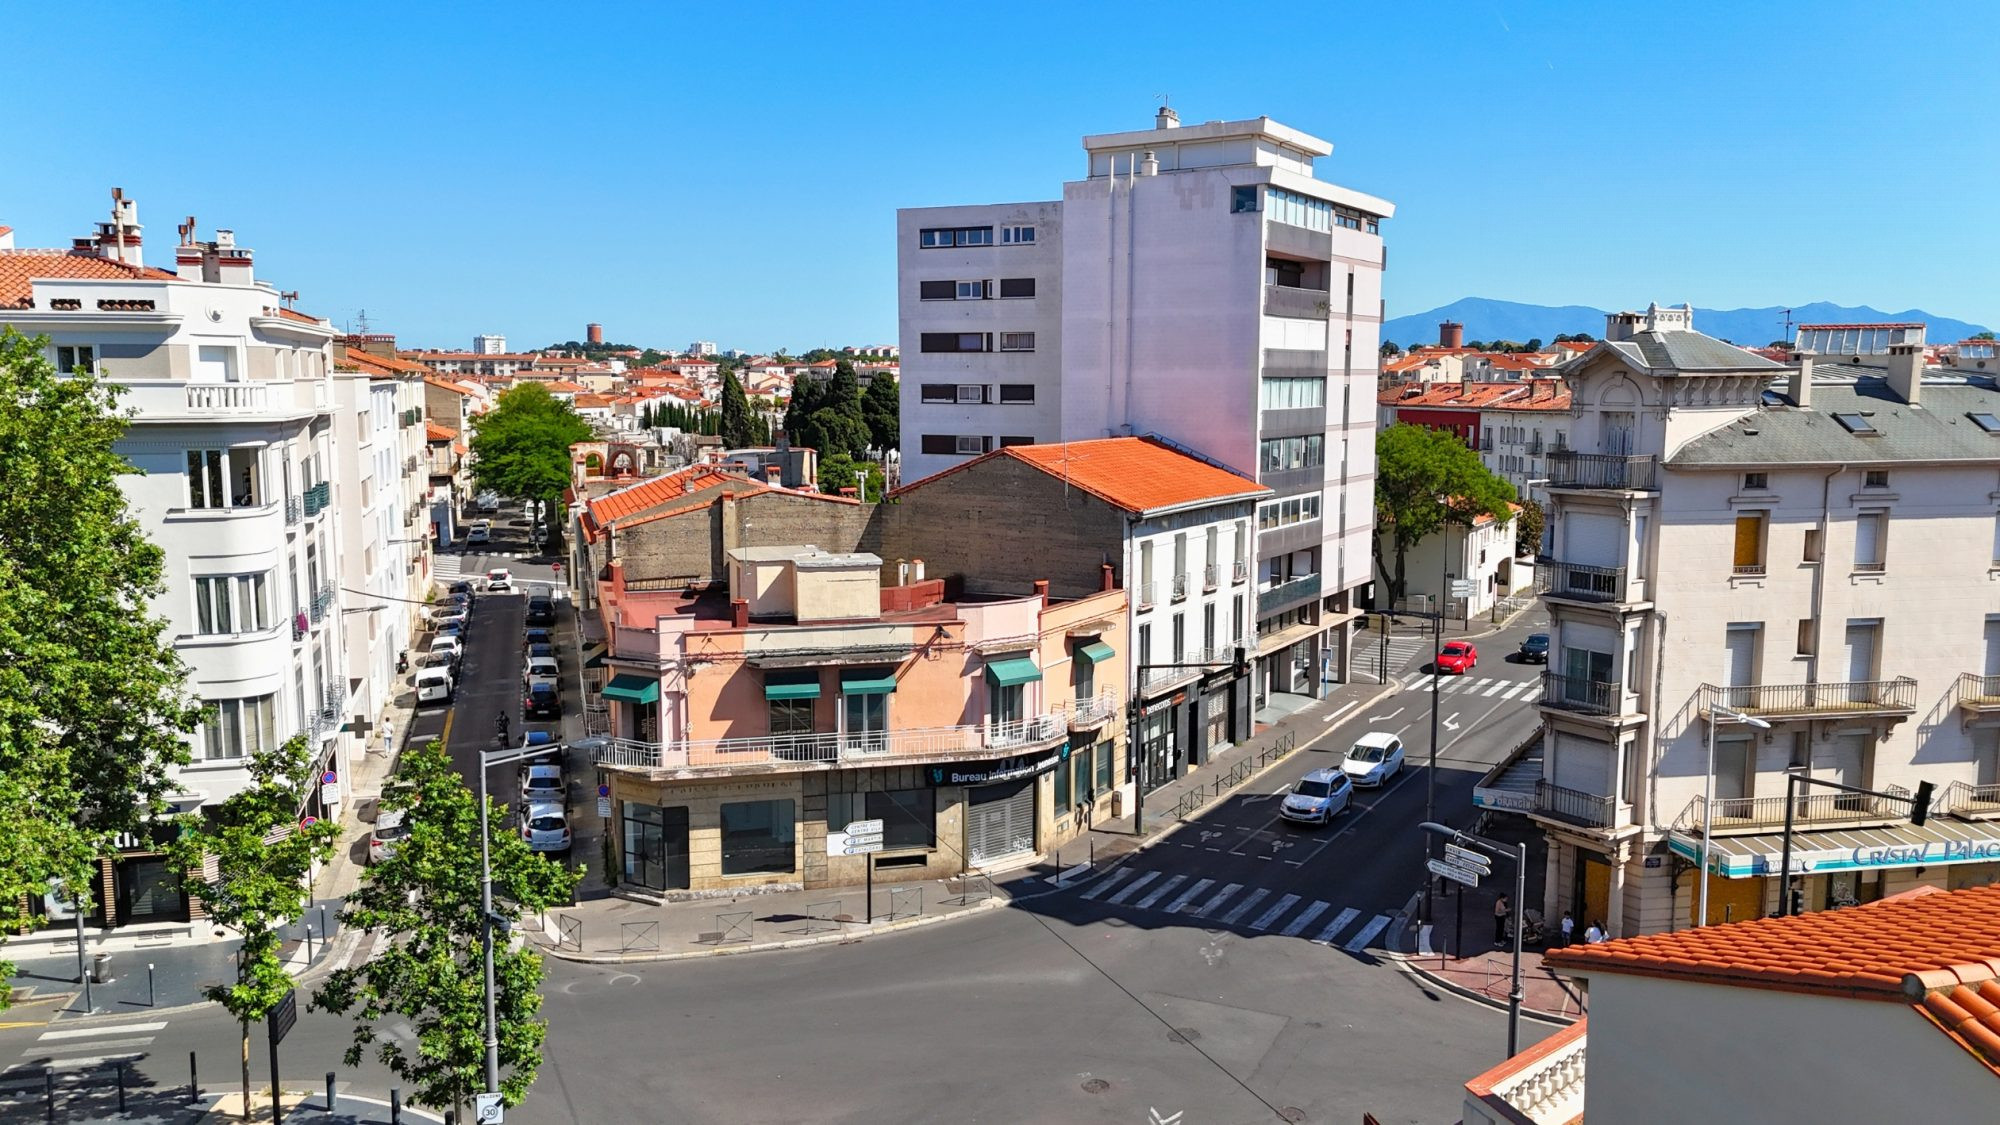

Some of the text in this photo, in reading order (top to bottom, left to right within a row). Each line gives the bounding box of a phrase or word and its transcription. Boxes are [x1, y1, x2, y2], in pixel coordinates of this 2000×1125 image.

[952, 773, 987, 783] Bureau
[989, 764, 1035, 780] Information
[485, 1108, 496, 1116] 30
